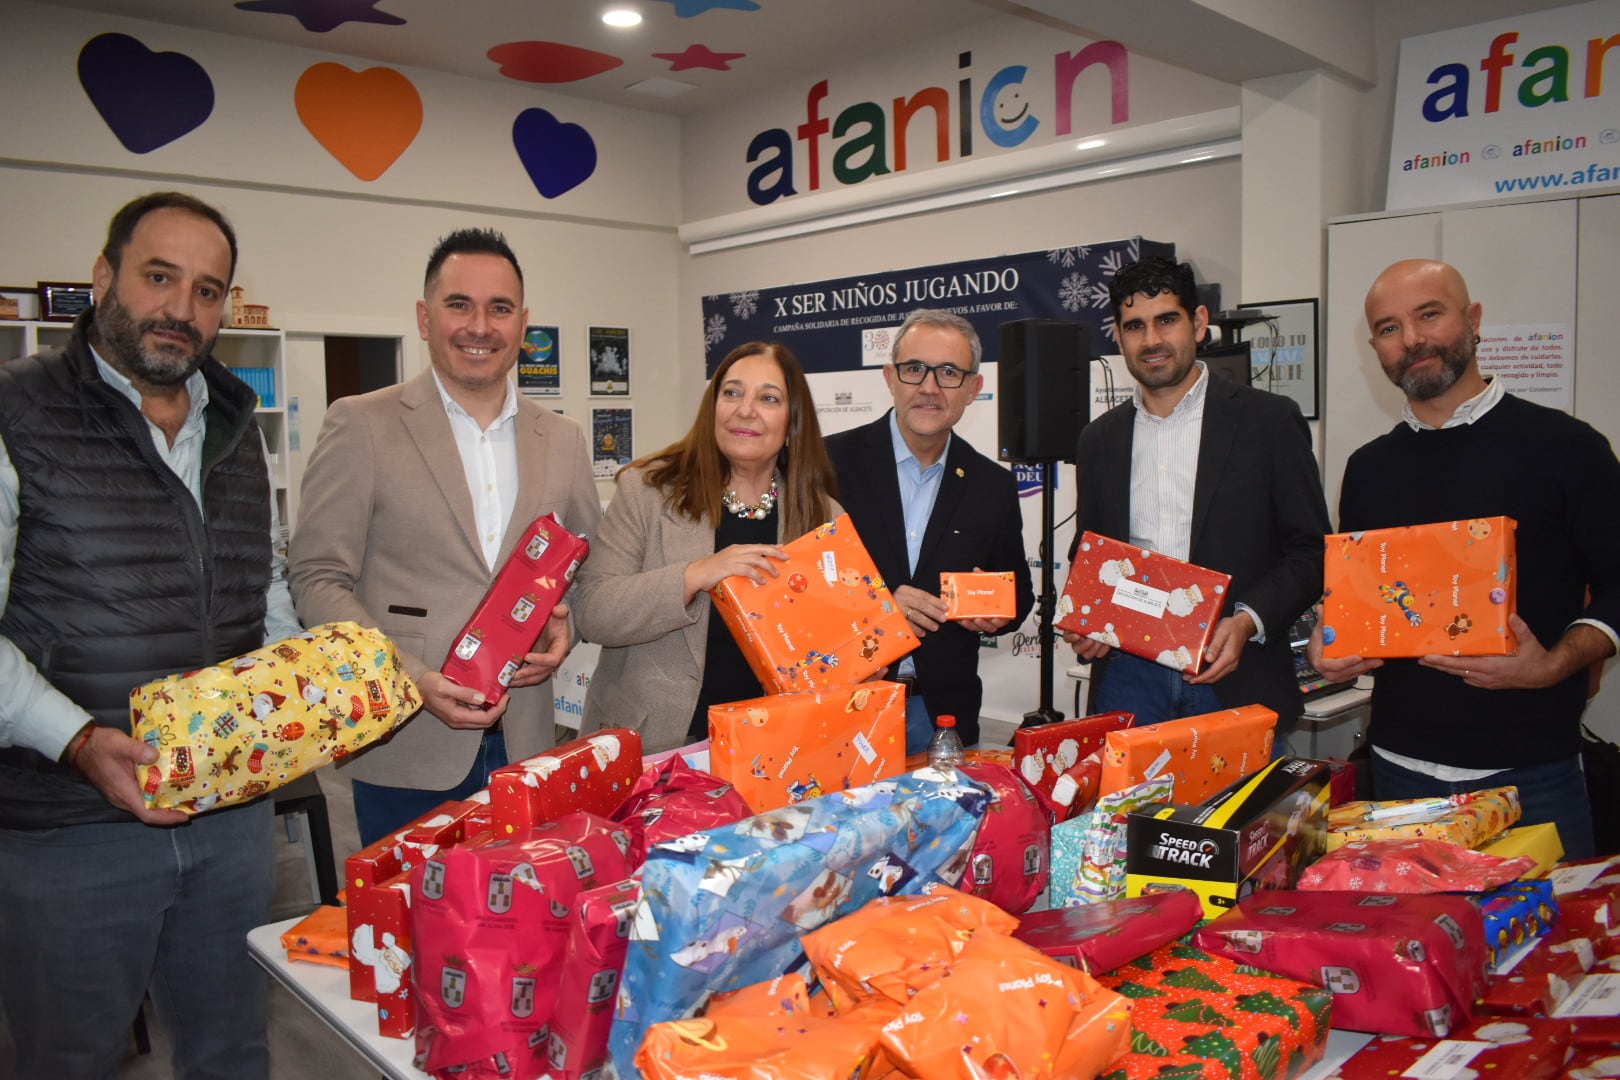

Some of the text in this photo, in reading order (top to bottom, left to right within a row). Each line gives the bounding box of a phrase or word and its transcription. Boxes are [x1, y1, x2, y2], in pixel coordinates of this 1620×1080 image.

[1512, 135, 1587, 157] afanion
[1403, 151, 1471, 171] afanion
[774, 267, 1019, 317] X SER NIÑOS JUGANDO
[976, 302, 1002, 313] FAVOR
[773, 321, 804, 333] CAMPAÑA
[805, 319, 840, 330] SOLIDARIA
[840, 318, 850, 327] DE
[851, 314, 886, 326] RECOGIDA
[888, 313, 898, 321] DE
[1528, 332, 1564, 341] afanion
[1512, 362, 1545, 370] actividad,
[1500, 371, 1529, 379] recogido
[1379, 541, 1387, 553] Toy
[966, 588, 994, 598] Toy Planet
[1451, 573, 1460, 607] Toy Planet
[1379, 614, 1387, 625] Toy
[1158, 845, 1214, 869] TRACK
